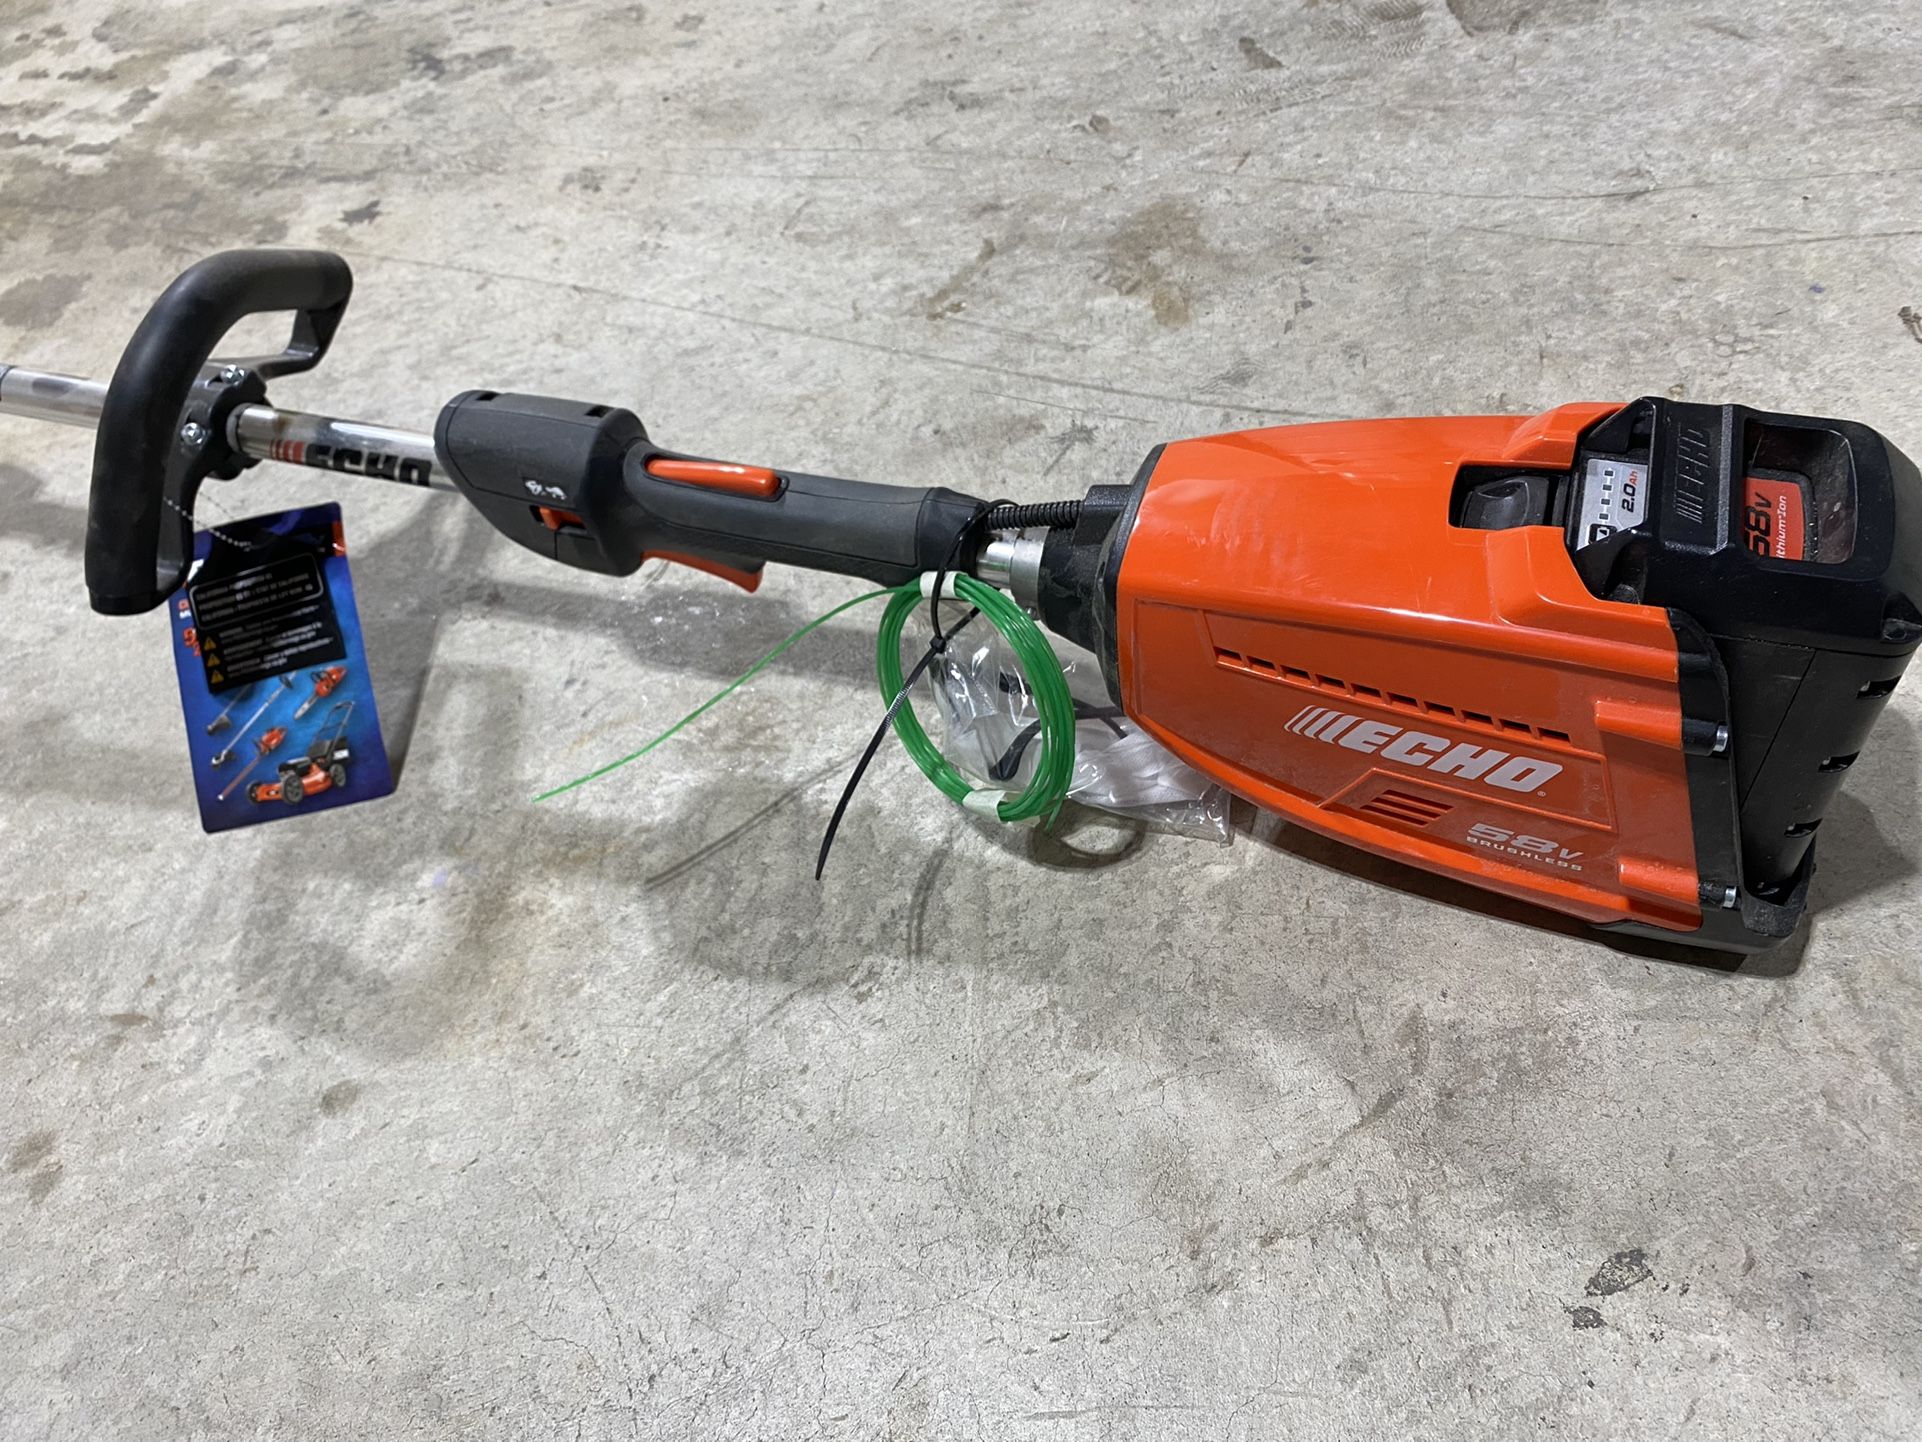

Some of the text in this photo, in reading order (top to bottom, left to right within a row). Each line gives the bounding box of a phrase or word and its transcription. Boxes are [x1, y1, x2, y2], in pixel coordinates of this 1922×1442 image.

[1621, 470, 1638, 513] 2.0Ah
[1744, 491, 1772, 558] 58V
[1775, 495, 1787, 559] ithium-Ion
[1338, 719, 1564, 793] ECHO
[1466, 836, 1582, 871] BRUSHLESS
[1467, 823, 1584, 860] 58V
